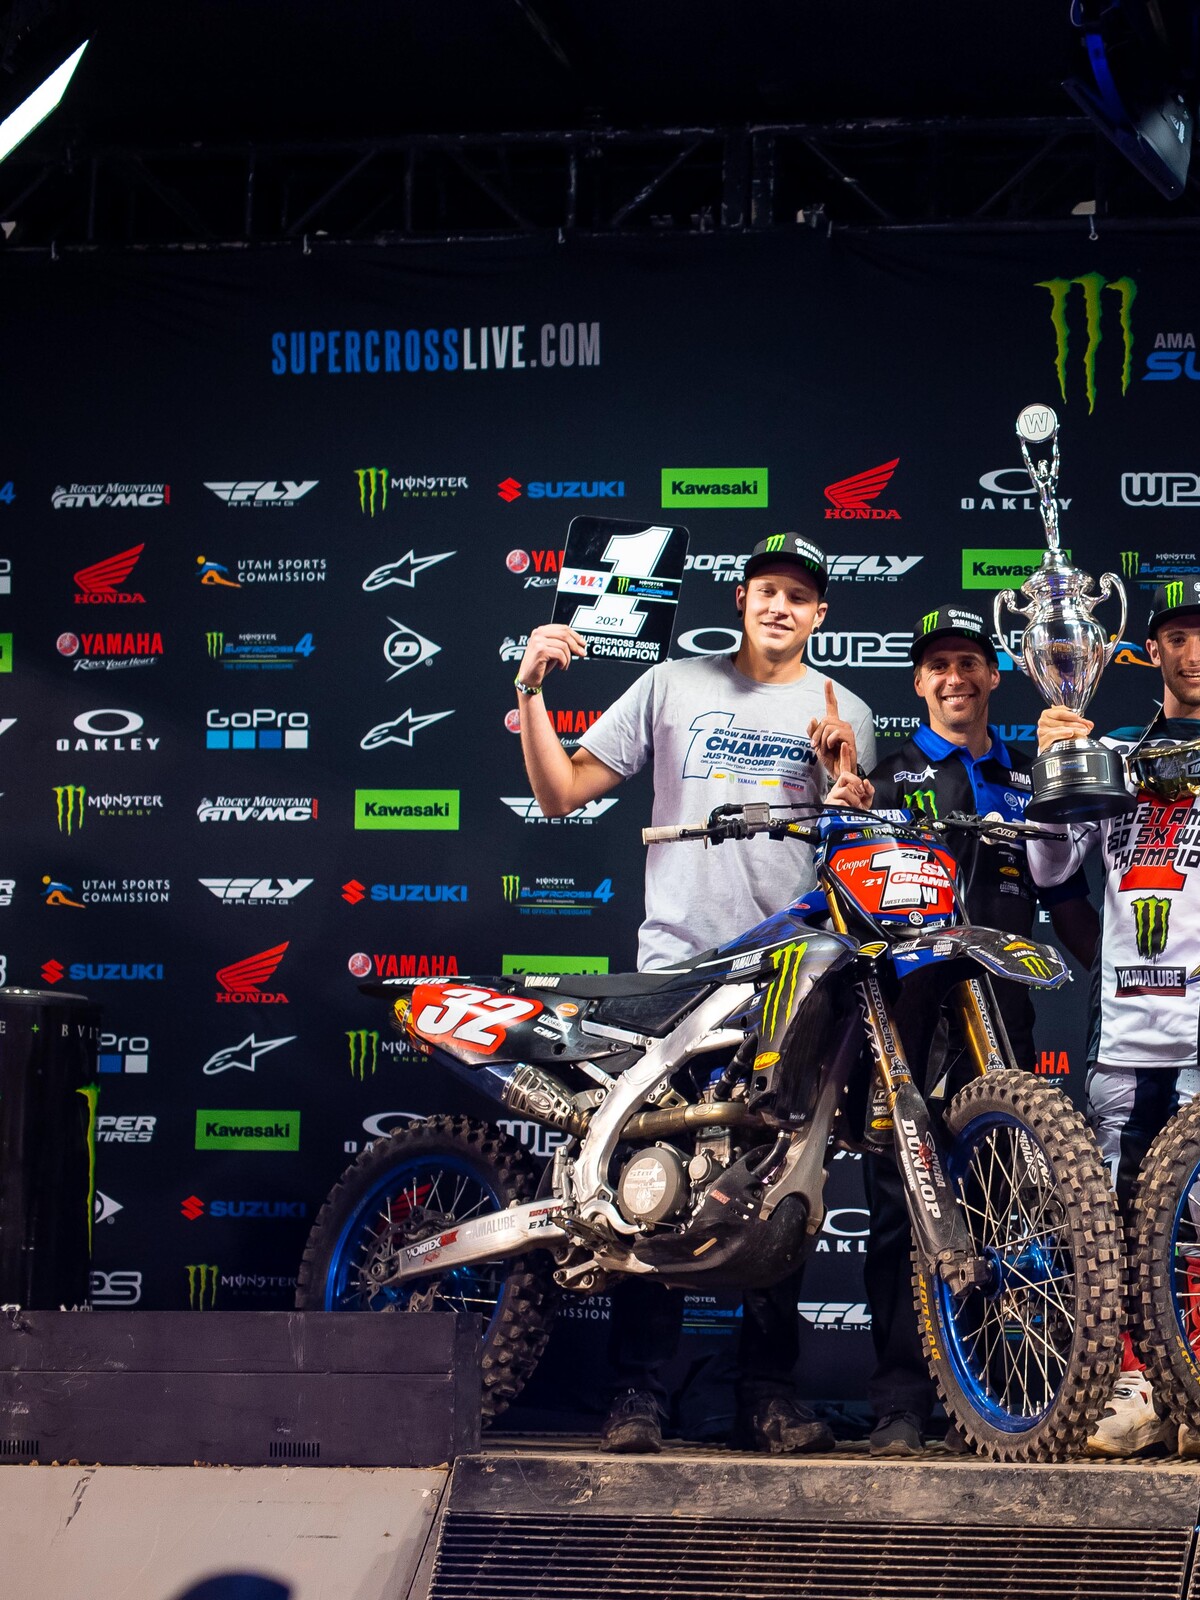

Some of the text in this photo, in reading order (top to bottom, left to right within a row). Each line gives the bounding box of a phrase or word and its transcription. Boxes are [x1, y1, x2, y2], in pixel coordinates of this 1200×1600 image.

[1155, 333, 1196, 349] AMA
[272, 322, 600, 377] SUPERCROSSLIVE.COM
[1024, 412, 1049, 433] W
[69, 482, 163, 493] ROCKY MOUNTAIN
[203, 481, 319, 500] FLY
[403, 490, 457, 498] ENERGY
[527, 481, 626, 498] SUZUKI
[672, 480, 758, 495] Kawasaki
[824, 509, 901, 520] HONDA
[238, 559, 326, 569] UTAH SPORTS
[238, 571, 326, 582] COMMISSION
[566, 574, 603, 588] AMA
[74, 593, 146, 604] HONDA
[595, 615, 625, 627] 2021
[81, 632, 163, 655] YAMAHA
[294, 633, 315, 657] 4
[592, 644, 660, 661] CHAMPION
[73, 658, 105, 672] Revs
[206, 709, 309, 728] GoPro
[713, 728, 760, 742] 250W AMA
[56, 738, 160, 751] OAKLEY
[706, 736, 818, 767] CHAMPION
[703, 752, 776, 767] JUSTIN COOPER
[88, 794, 163, 808] MONSTER
[215, 796, 312, 807] ROCKY MOUNTAIN
[364, 802, 449, 818] Kawasaki
[525, 817, 594, 825] RACING
[1135, 827, 1168, 846] SX
[901, 852, 925, 861] 250
[836, 858, 870, 876] Cooper
[82, 880, 170, 889] UTAH SPORTS
[198, 879, 314, 899] FLY
[592, 878, 615, 904] 4
[82, 891, 170, 903] COMMISSION
[371, 884, 467, 902] SUZUKI
[922, 886, 938, 905] W
[69, 964, 163, 980] SUZUKI
[374, 954, 458, 977] YAMAHA
[524, 976, 560, 988] YAMAHA
[1118, 969, 1182, 987] YAMALUBE
[216, 992, 289, 1003] HONDA
[416, 988, 536, 1047] 32
[206, 1122, 290, 1137] Kawasaki
[210, 1201, 306, 1217] SUZUKI
[406, 1236, 442, 1261] VORTEX
